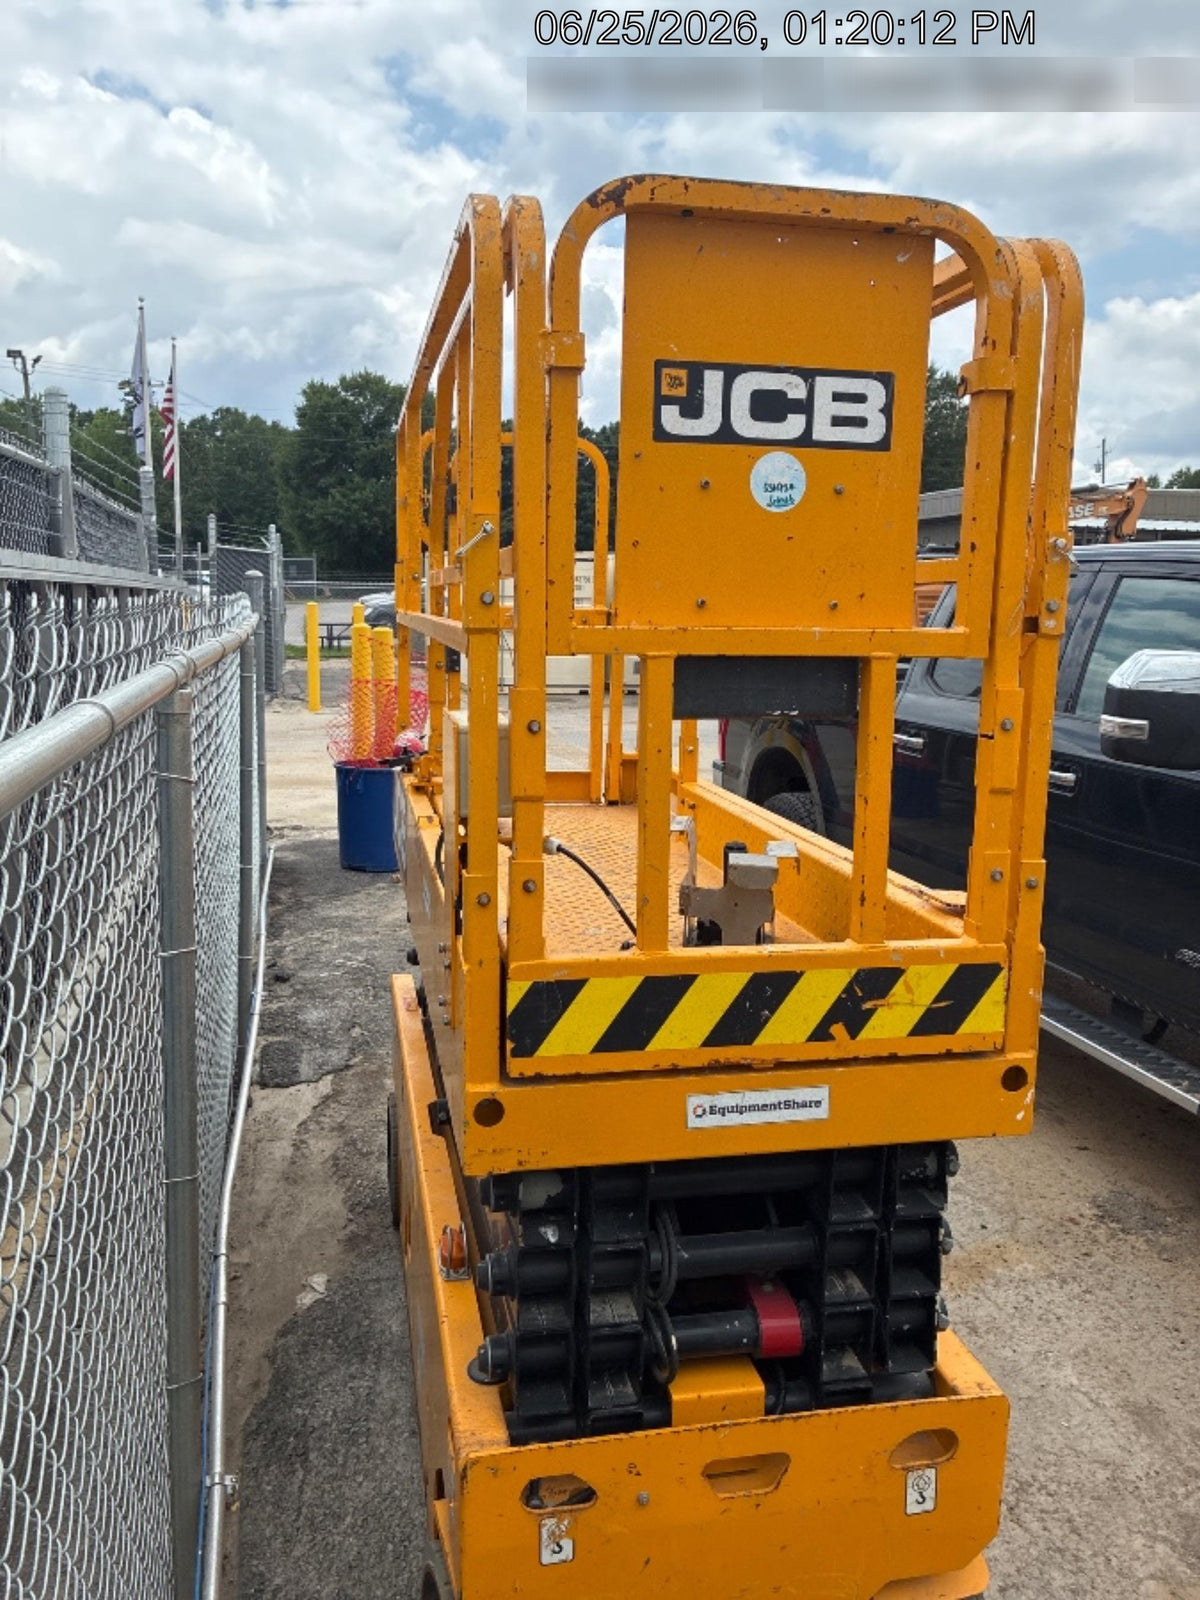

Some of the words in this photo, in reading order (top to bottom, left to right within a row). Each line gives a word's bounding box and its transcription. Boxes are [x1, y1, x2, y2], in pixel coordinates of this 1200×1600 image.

[660, 369, 887, 443] JCB
[1068, 503, 1094, 518] ASE
[709, 1099, 823, 1117] EquipmentShare
